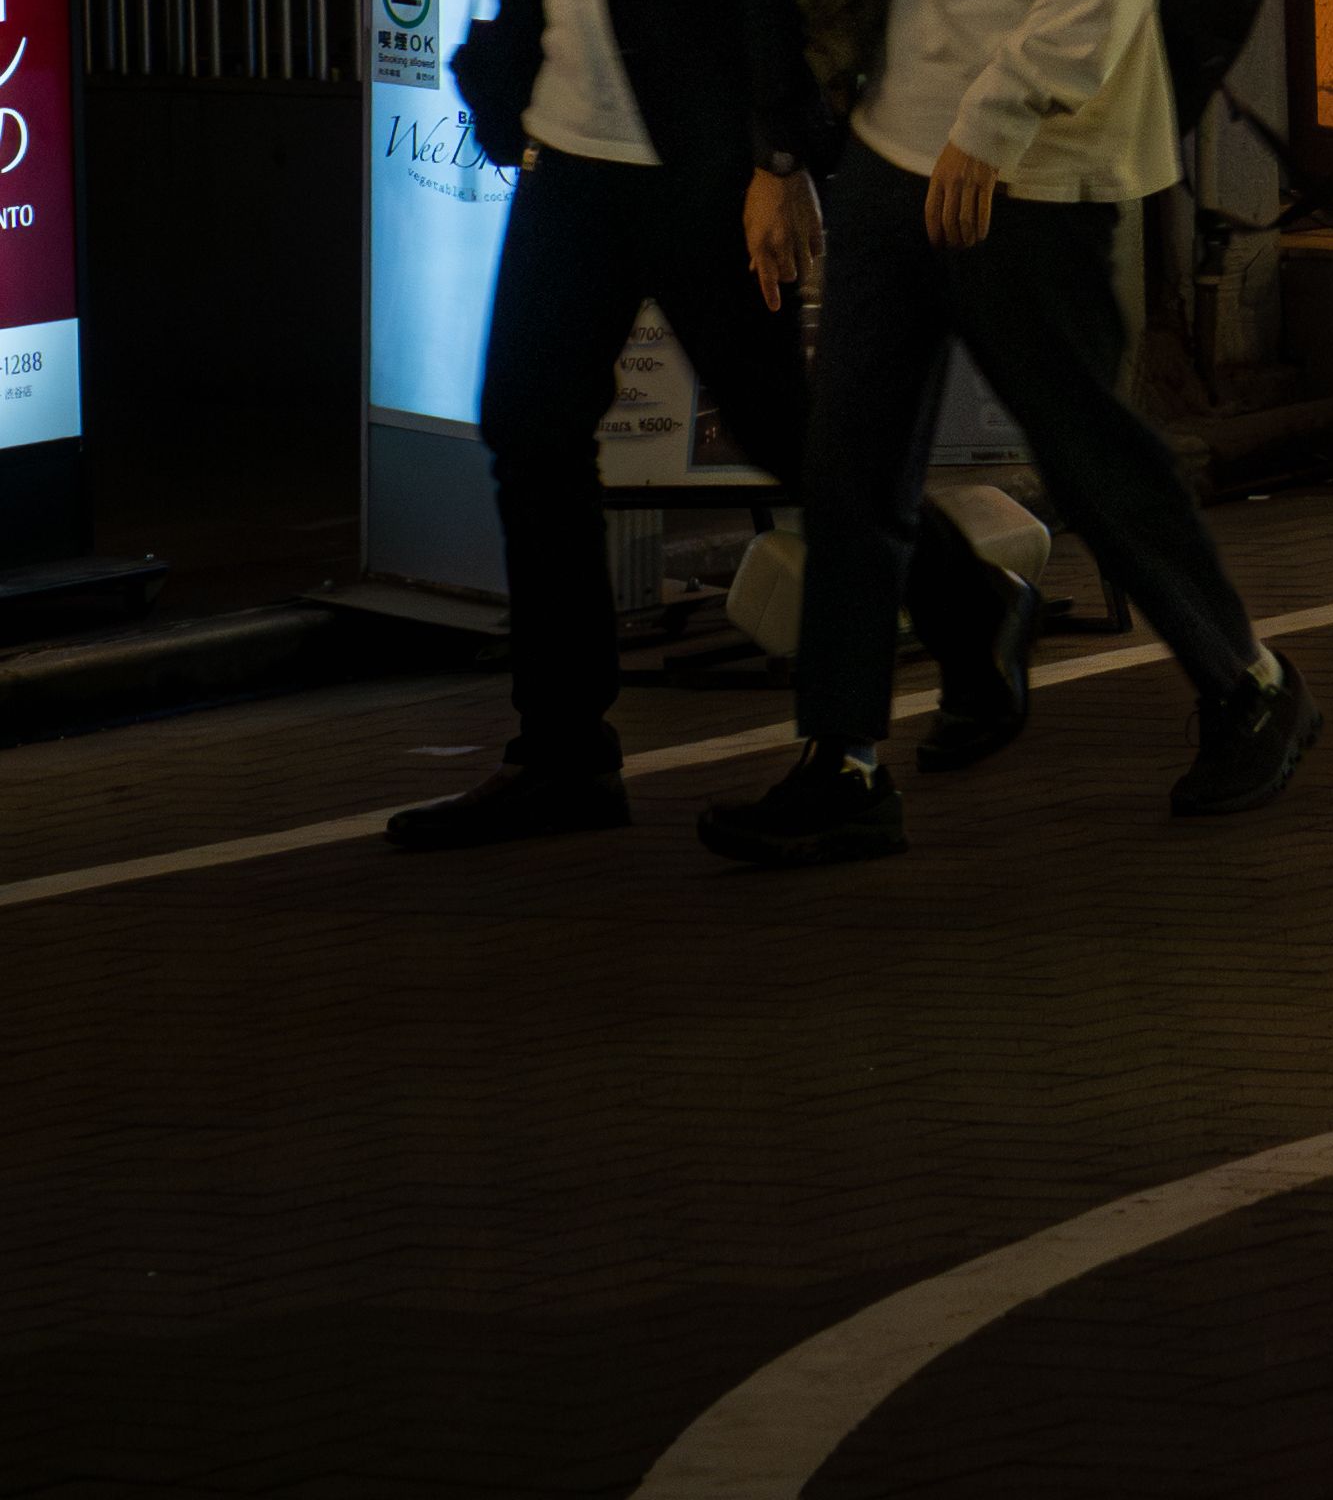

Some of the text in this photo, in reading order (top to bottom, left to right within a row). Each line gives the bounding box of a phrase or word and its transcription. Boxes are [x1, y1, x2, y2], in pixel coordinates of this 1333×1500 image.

[377, 30, 435, 55] 喫煙OK
[378, 53, 436, 70] Smoking allowed
[386, 115, 449, 164] Wee
